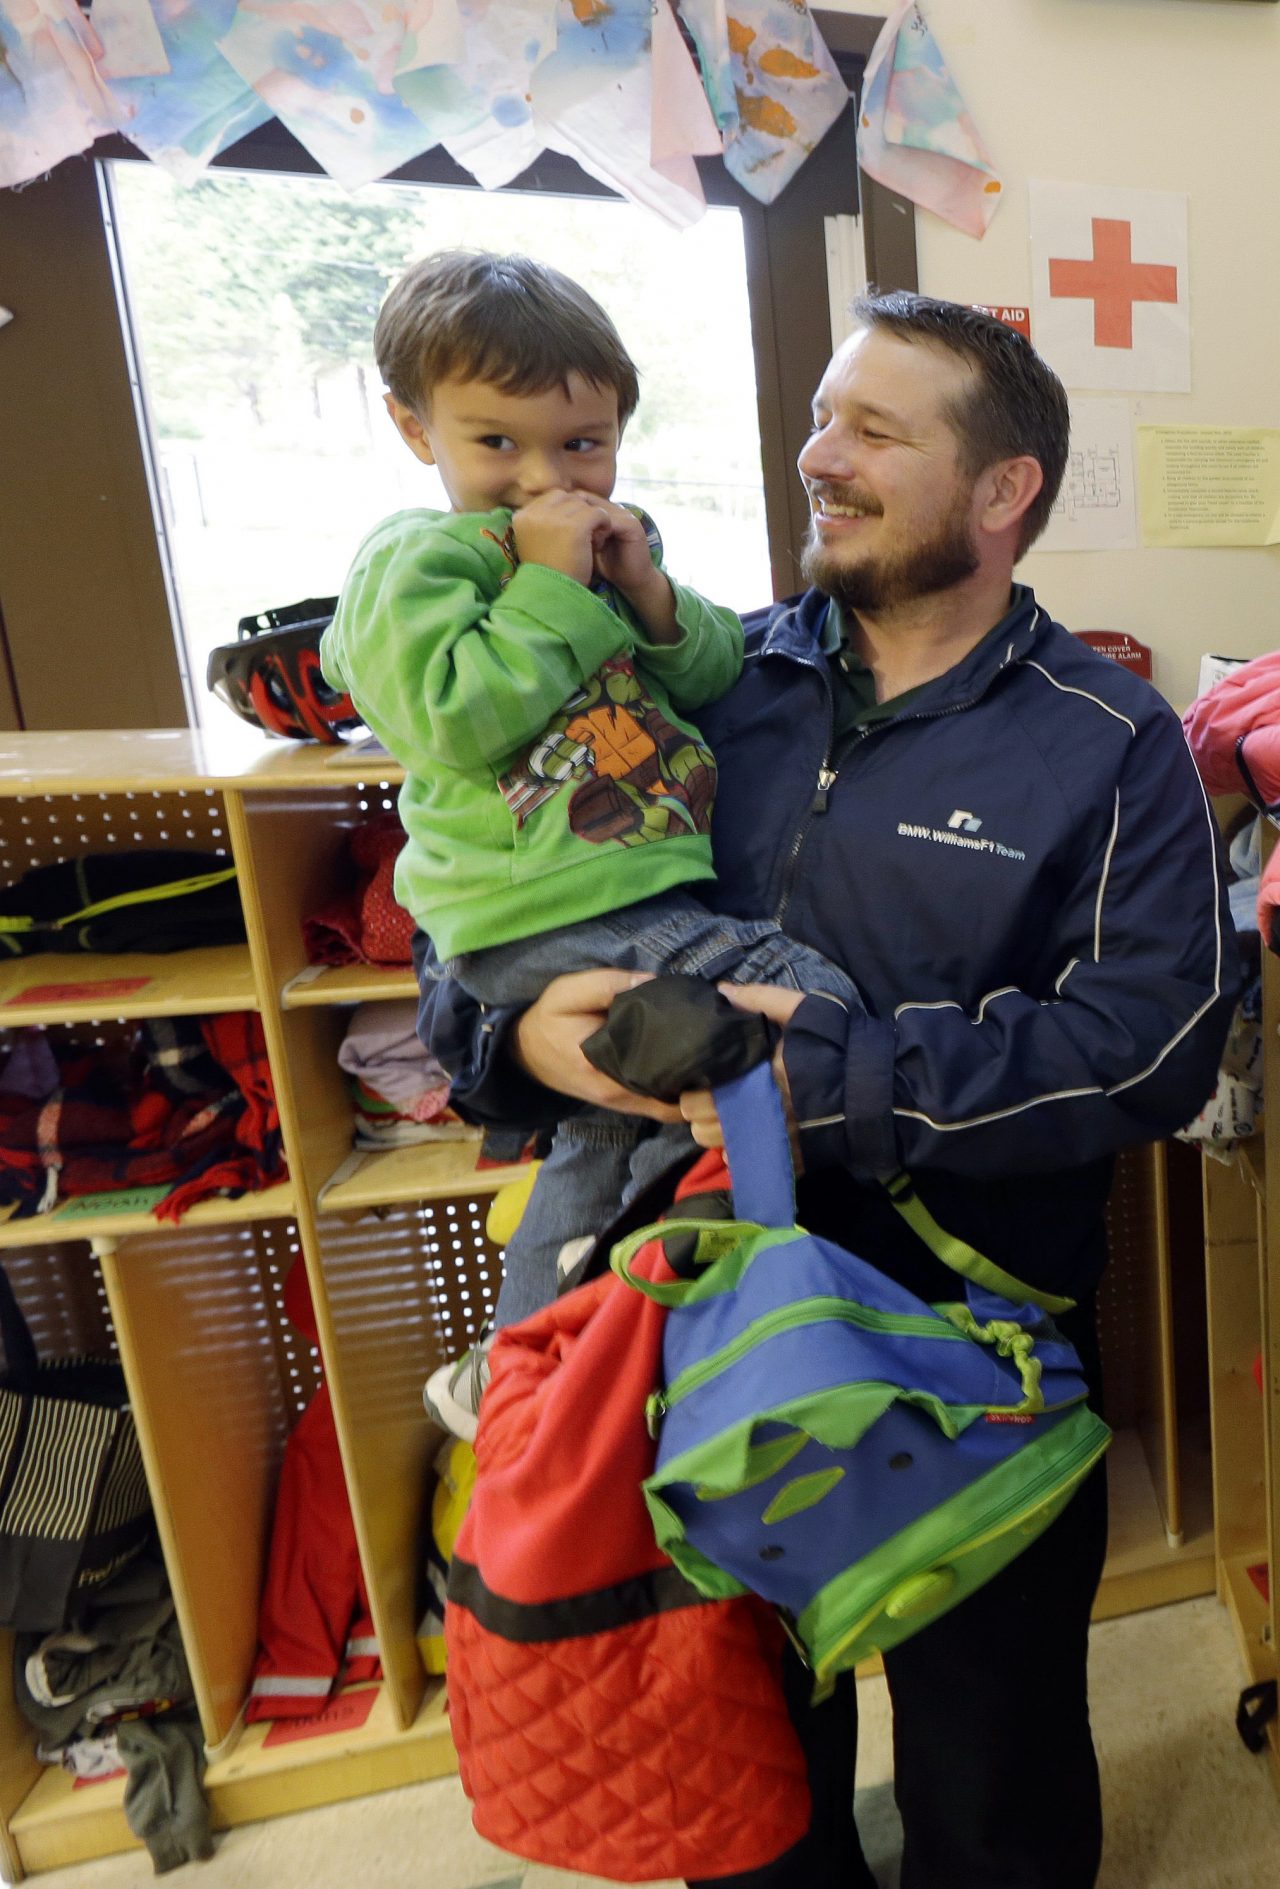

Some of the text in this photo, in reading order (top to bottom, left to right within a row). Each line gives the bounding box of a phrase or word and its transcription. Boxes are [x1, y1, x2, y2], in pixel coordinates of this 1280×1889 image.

[1002, 309, 1025, 321] AID
[1107, 645, 1131, 653] COVER
[1118, 652, 1142, 660] ALARM
[995, 841, 1026, 861] Team
